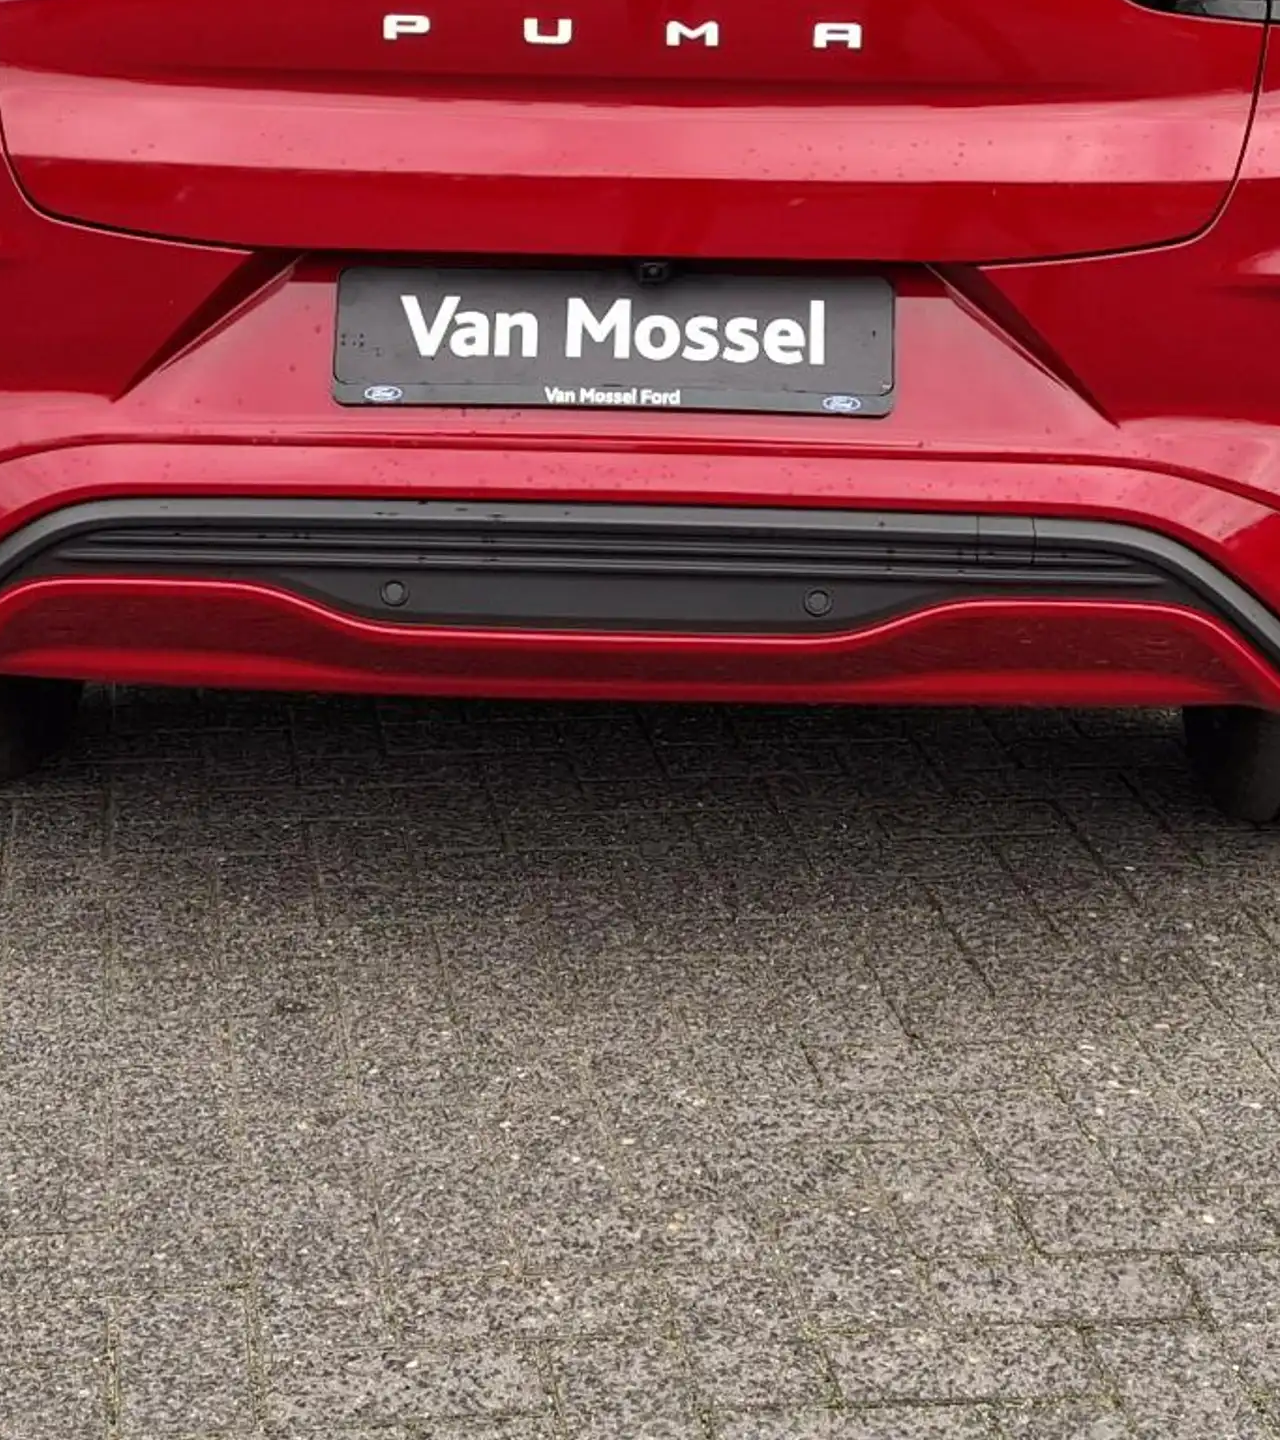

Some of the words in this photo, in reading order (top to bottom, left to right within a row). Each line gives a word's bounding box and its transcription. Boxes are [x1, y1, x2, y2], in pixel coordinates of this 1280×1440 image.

[382, 13, 863, 49] PUMA
[400, 296, 537, 359] Van
[565, 298, 827, 366] Mossel
[545, 387, 576, 405] Van
[580, 388, 638, 406] Mossel
[640, 390, 681, 407] Ford
